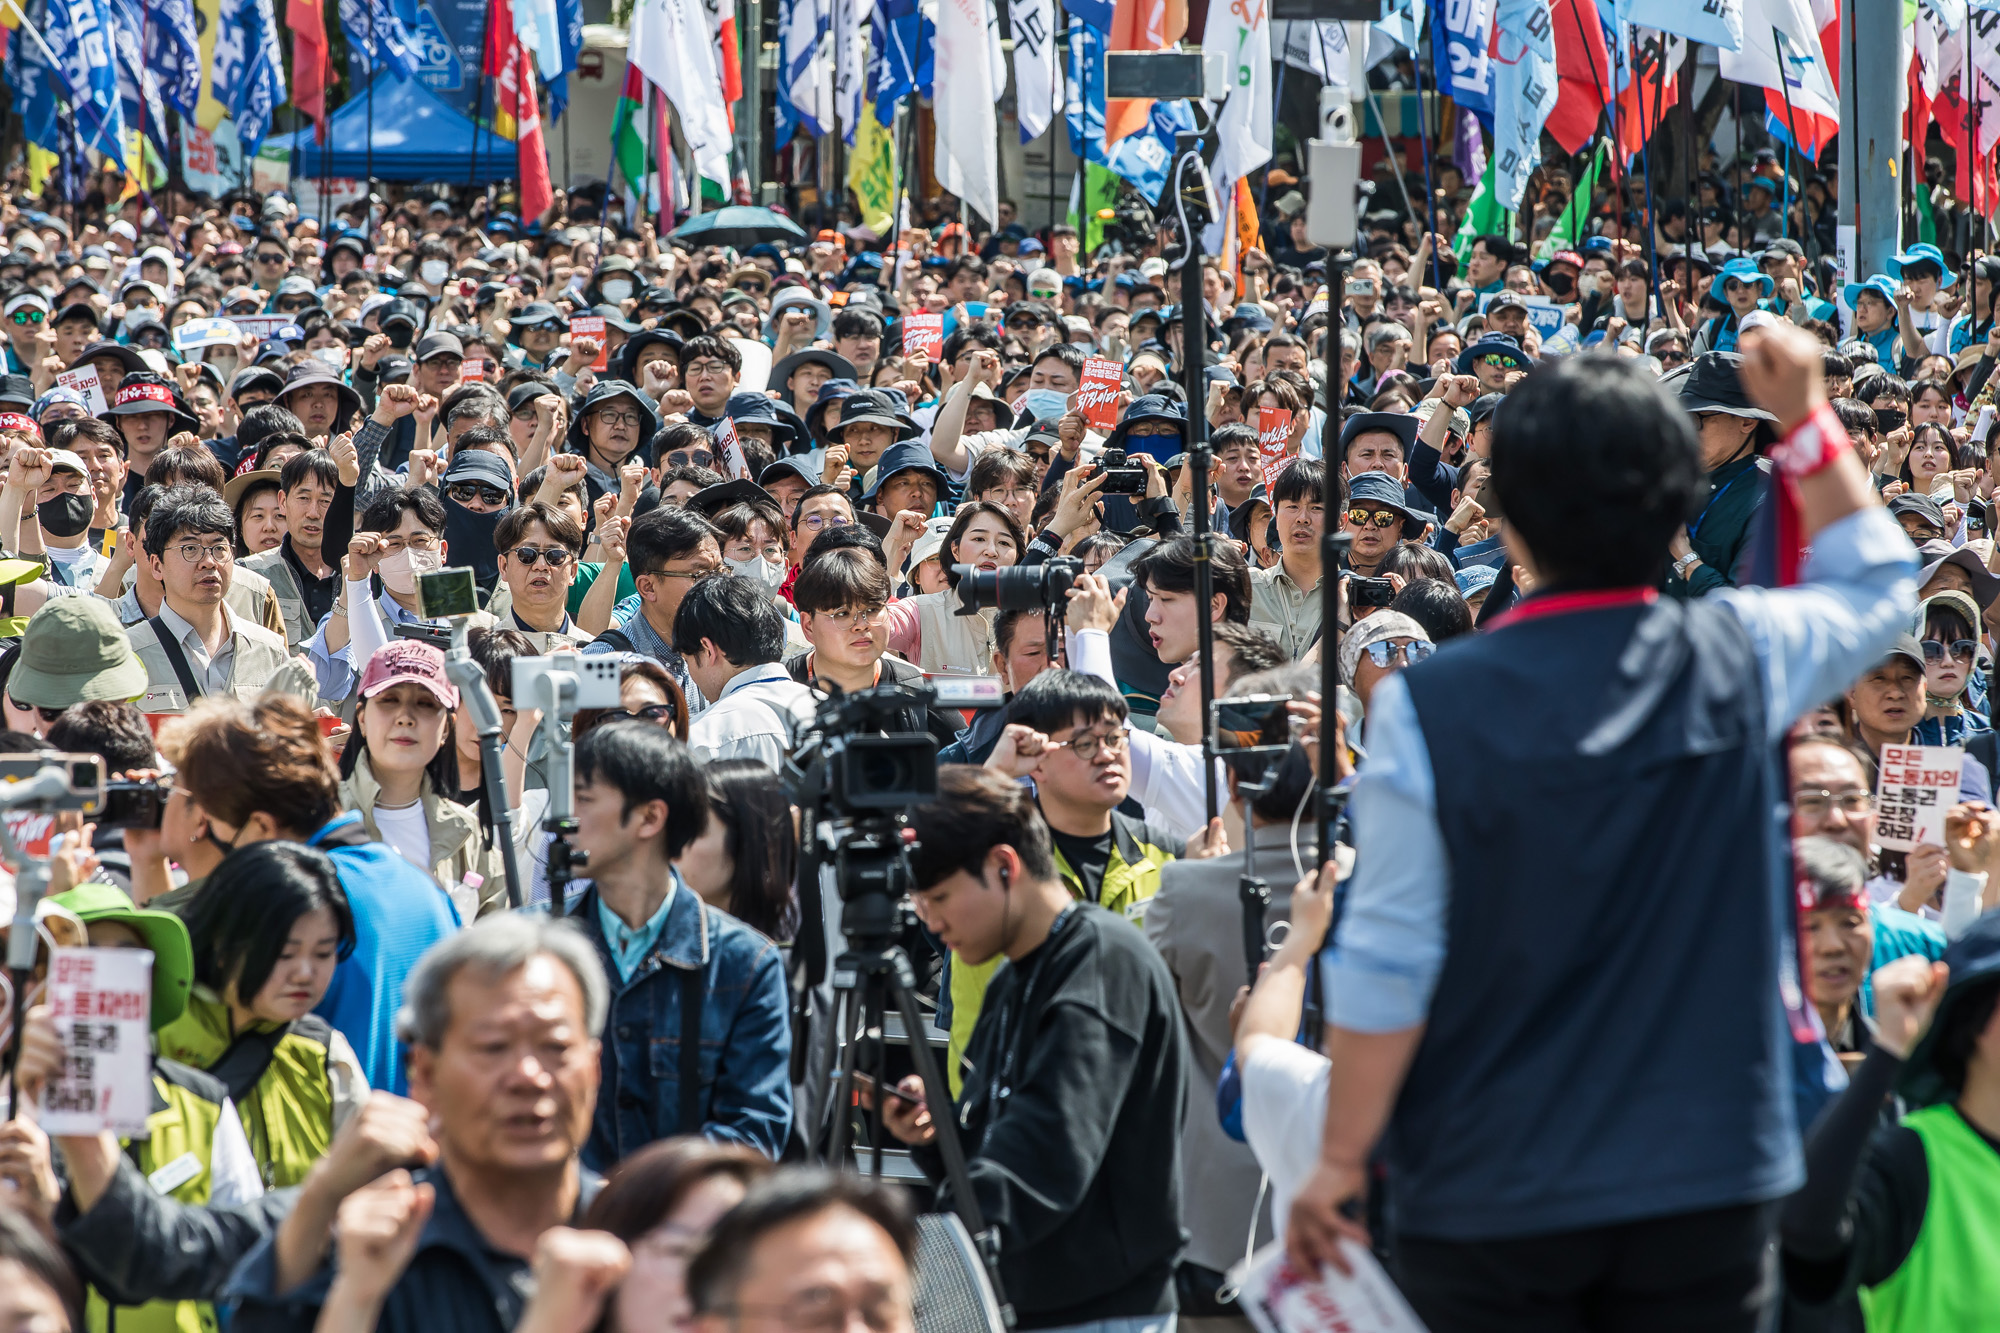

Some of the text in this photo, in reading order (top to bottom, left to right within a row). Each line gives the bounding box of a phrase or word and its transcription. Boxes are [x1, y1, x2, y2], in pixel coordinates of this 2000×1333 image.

[58, 372, 77, 385] 모든
[70, 377, 98, 392] 동자의
[141, 386, 165, 399] 투쟁
[1076, 389, 1120, 412] 퇴진이다
[1885, 748, 1923, 767] 모든
[1883, 767, 1958, 787] 노동자의
[1881, 786, 1937, 806] 노동권
[1878, 804, 1916, 823] 보장
[53, 955, 95, 988] 모든
